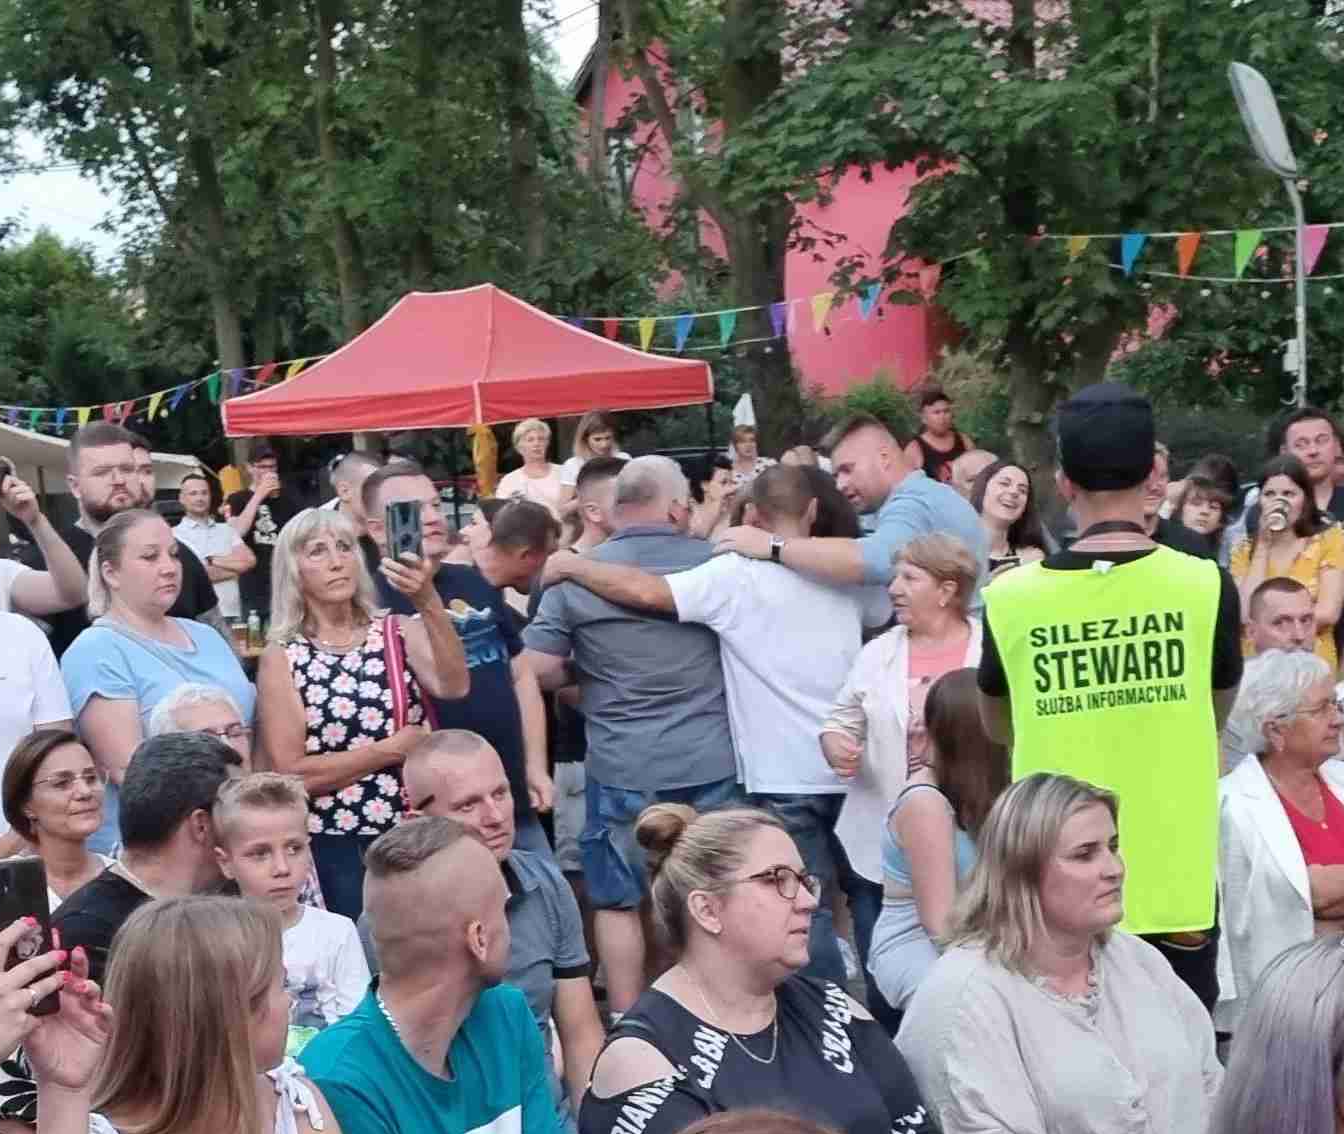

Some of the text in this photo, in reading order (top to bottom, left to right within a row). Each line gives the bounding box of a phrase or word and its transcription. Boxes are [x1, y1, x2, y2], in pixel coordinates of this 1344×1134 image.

[1030, 611, 1184, 648] SILEZJAN
[1033, 638, 1185, 693] STEWARD
[1087, 683, 1187, 711] INFORMACYJNA
